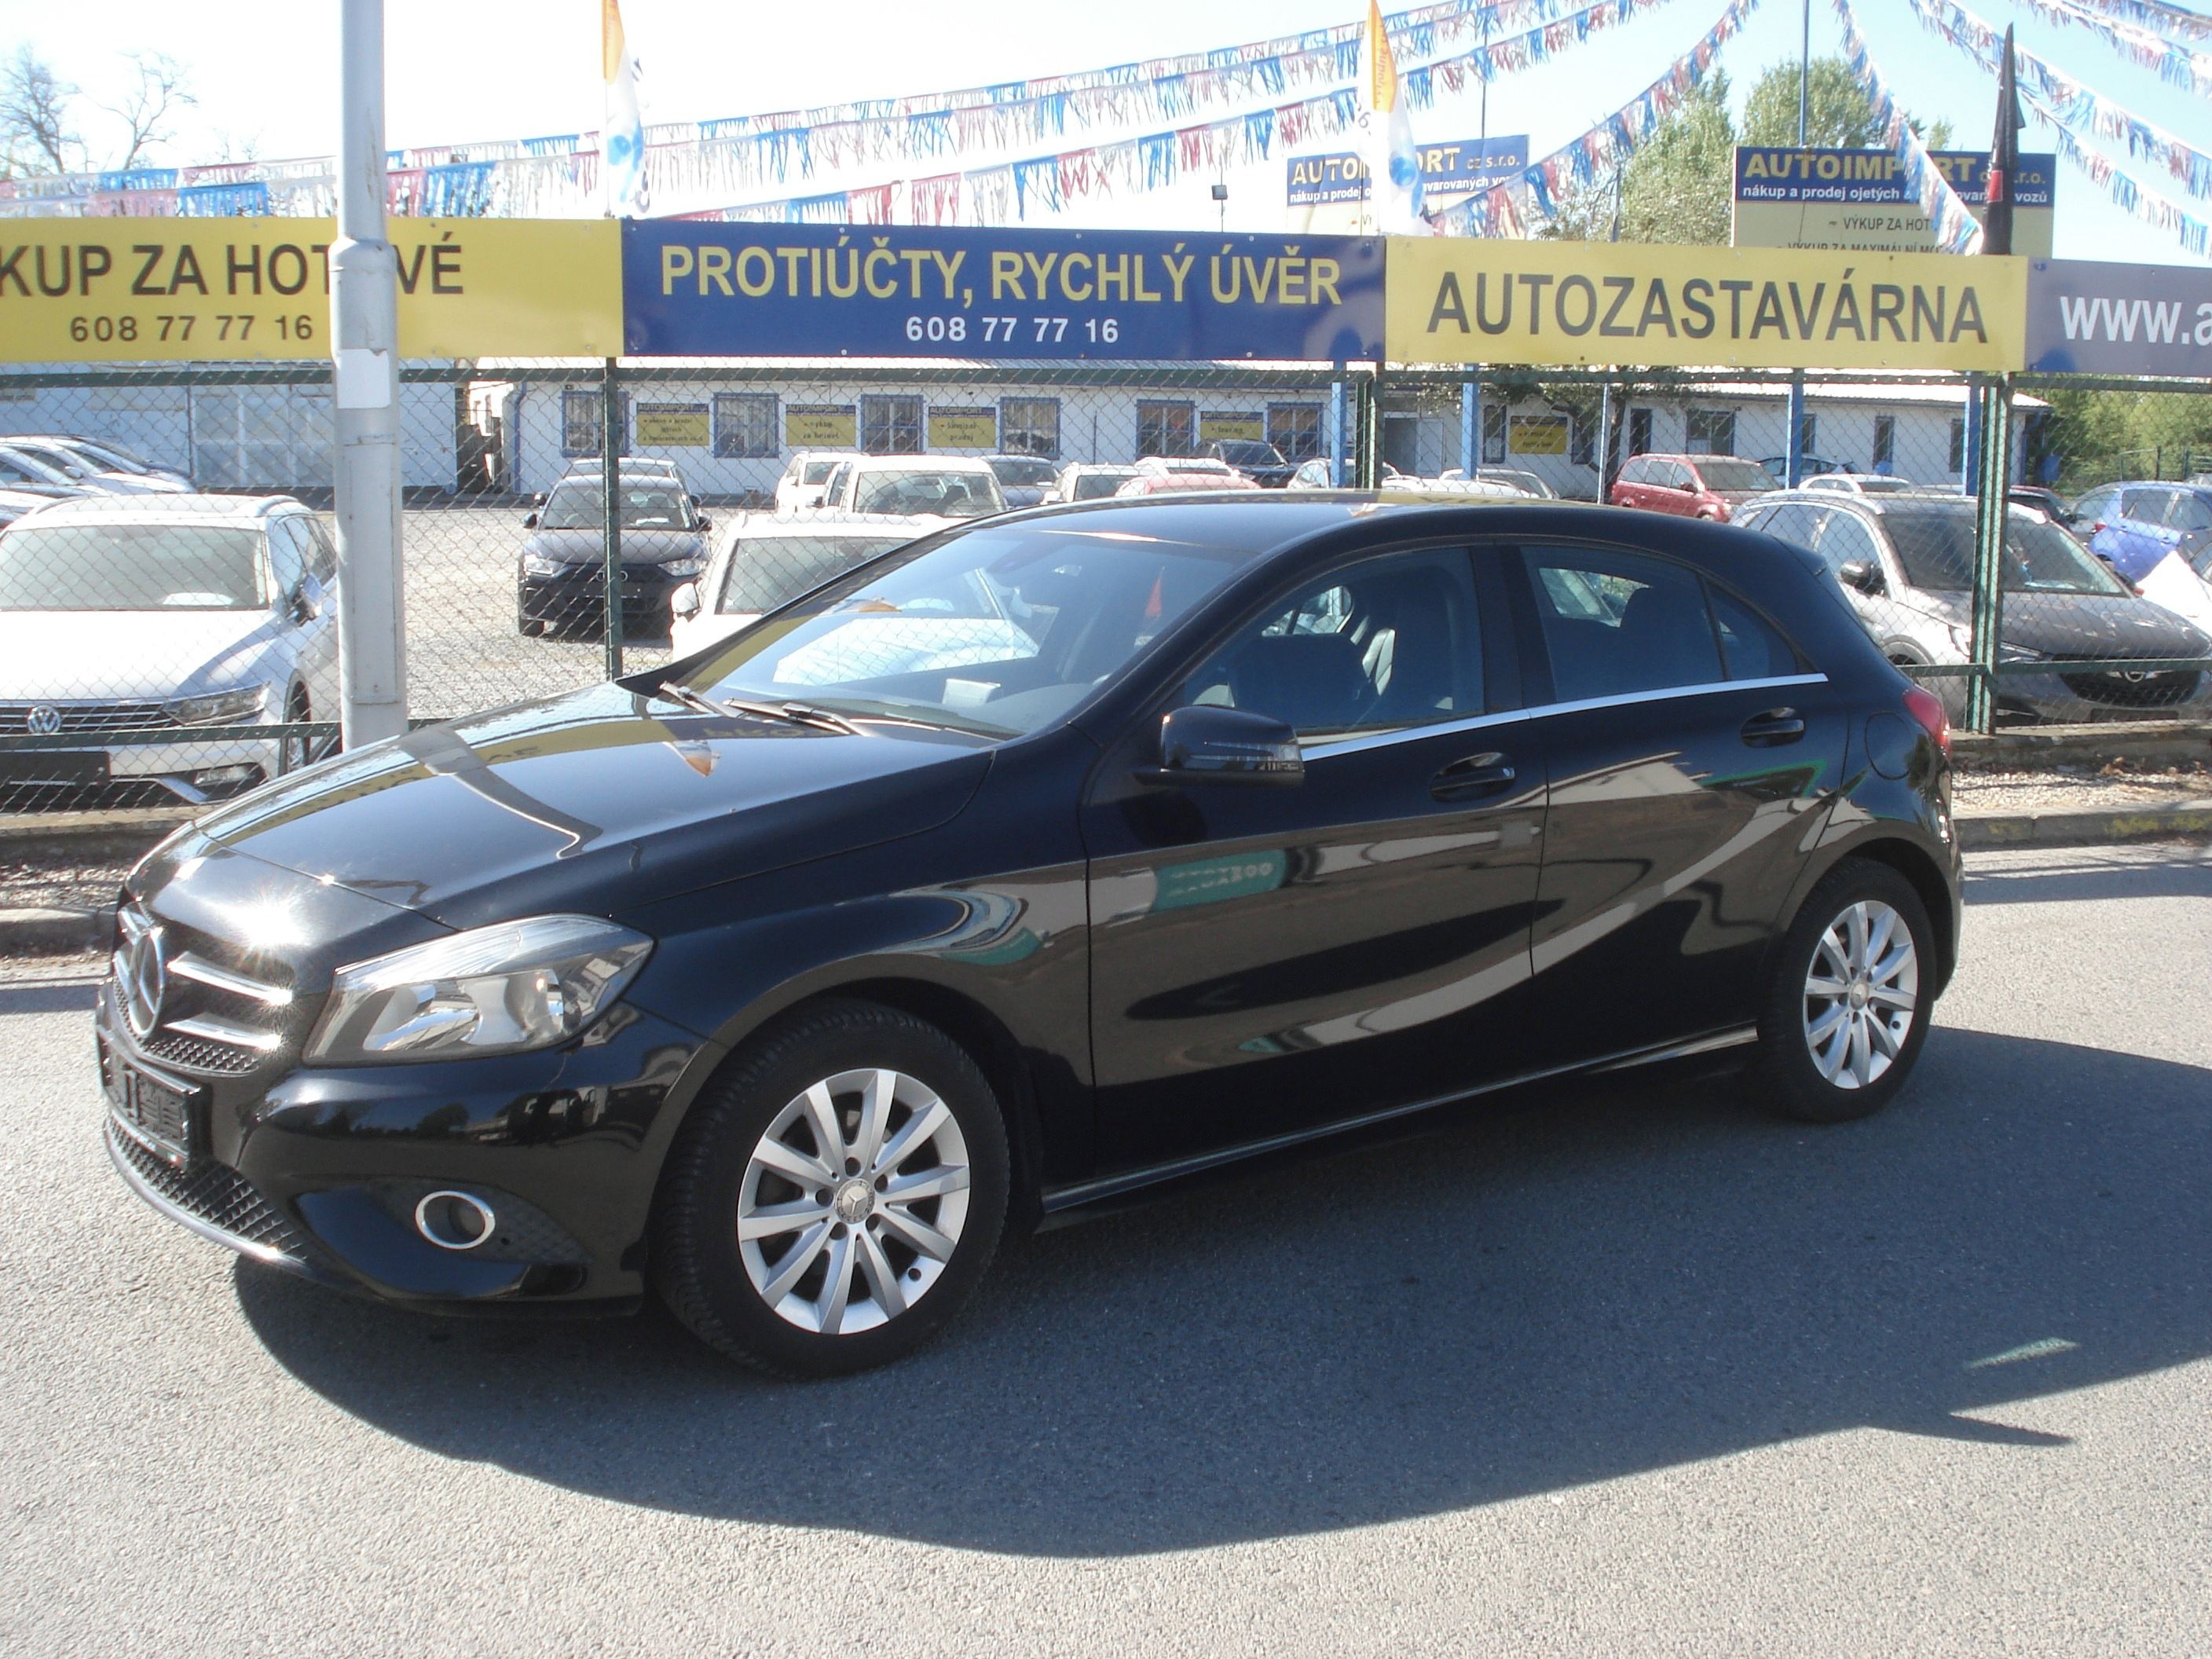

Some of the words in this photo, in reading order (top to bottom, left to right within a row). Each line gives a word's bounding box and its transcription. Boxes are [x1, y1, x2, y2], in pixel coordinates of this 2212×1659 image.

[1291, 147, 1460, 185] AUTOIRT
[1485, 155, 1520, 168] s.r.o.
[1744, 152, 1976, 182] AUTOIMPRT
[2014, 172, 2046, 185] .r.o.
[1290, 189, 1320, 203] nákup
[1322, 191, 1328, 200] a
[1331, 185, 1362, 202] prodej
[1743, 185, 1786, 200] nákup
[1789, 188, 1798, 197] a
[1802, 186, 1846, 202] prodej
[1850, 186, 1900, 202] ojetých
[1843, 214, 1884, 231] VÝKUP
[1887, 218, 1903, 231] ZA
[1906, 218, 1932, 232] HOT
[131, 244, 209, 295] ZA
[226, 231, 464, 295] HOTVÉ
[661, 236, 973, 309] PROTIÚČTY,
[991, 243, 1196, 302] RYCHLÝ
[1210, 244, 1342, 305] ÚVĚR
[1426, 268, 1988, 344] AUTOZASTAVÁRNA
[70, 316, 138, 342] 608
[156, 315, 196, 341] 77
[215, 315, 255, 340] 77
[275, 315, 313, 340] 16
[906, 316, 967, 342] 608
[982, 317, 1017, 342] 77
[1034, 317, 1068, 342] 77
[1085, 318, 1119, 343] 16
